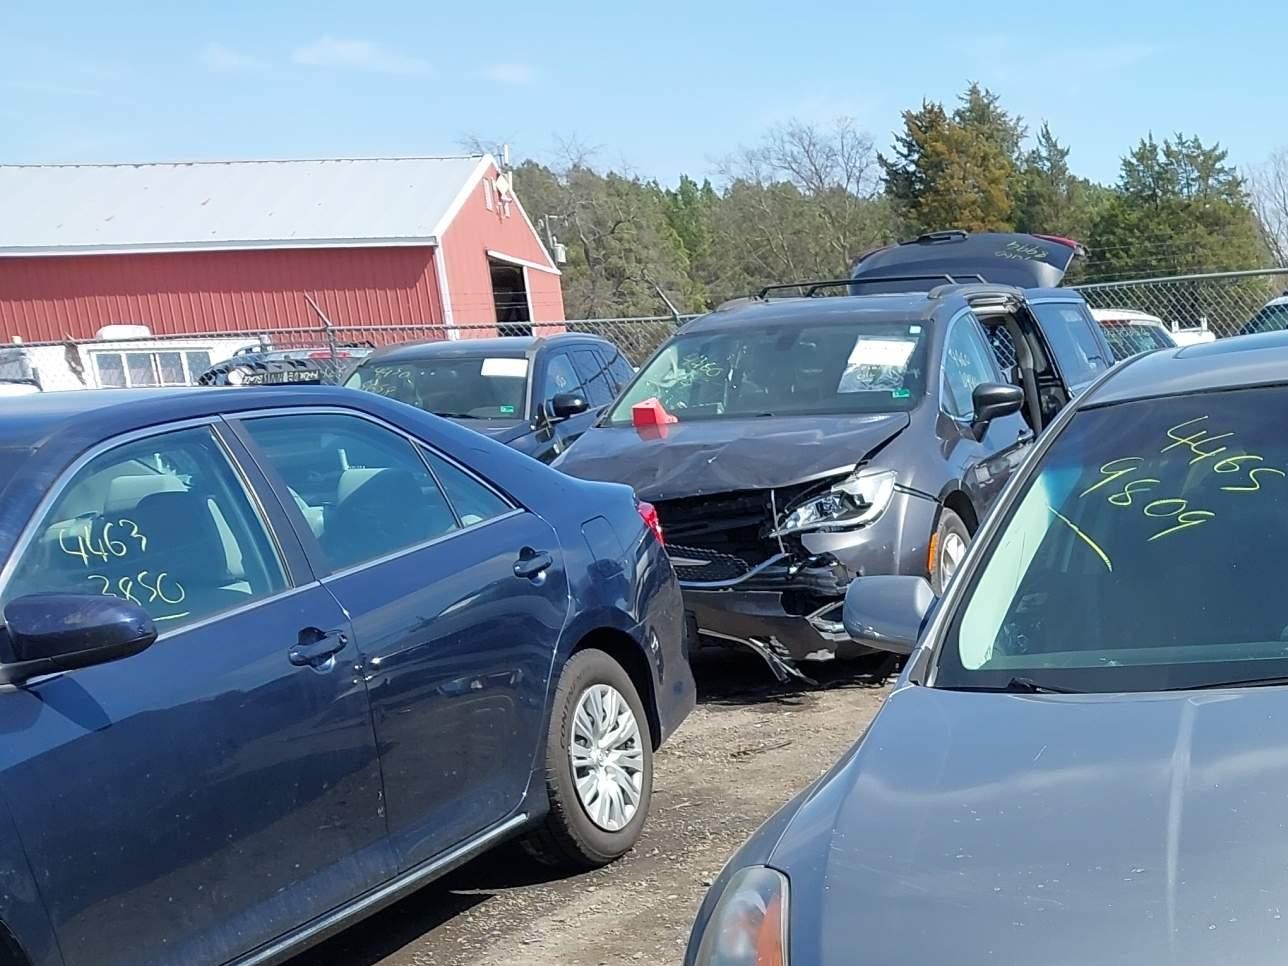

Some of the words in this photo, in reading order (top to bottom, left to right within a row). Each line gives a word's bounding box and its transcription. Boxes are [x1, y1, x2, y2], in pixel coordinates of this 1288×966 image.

[1160, 415, 1286, 491] 4465
[1079, 456, 1216, 541] 9809
[58, 519, 147, 568] 4463
